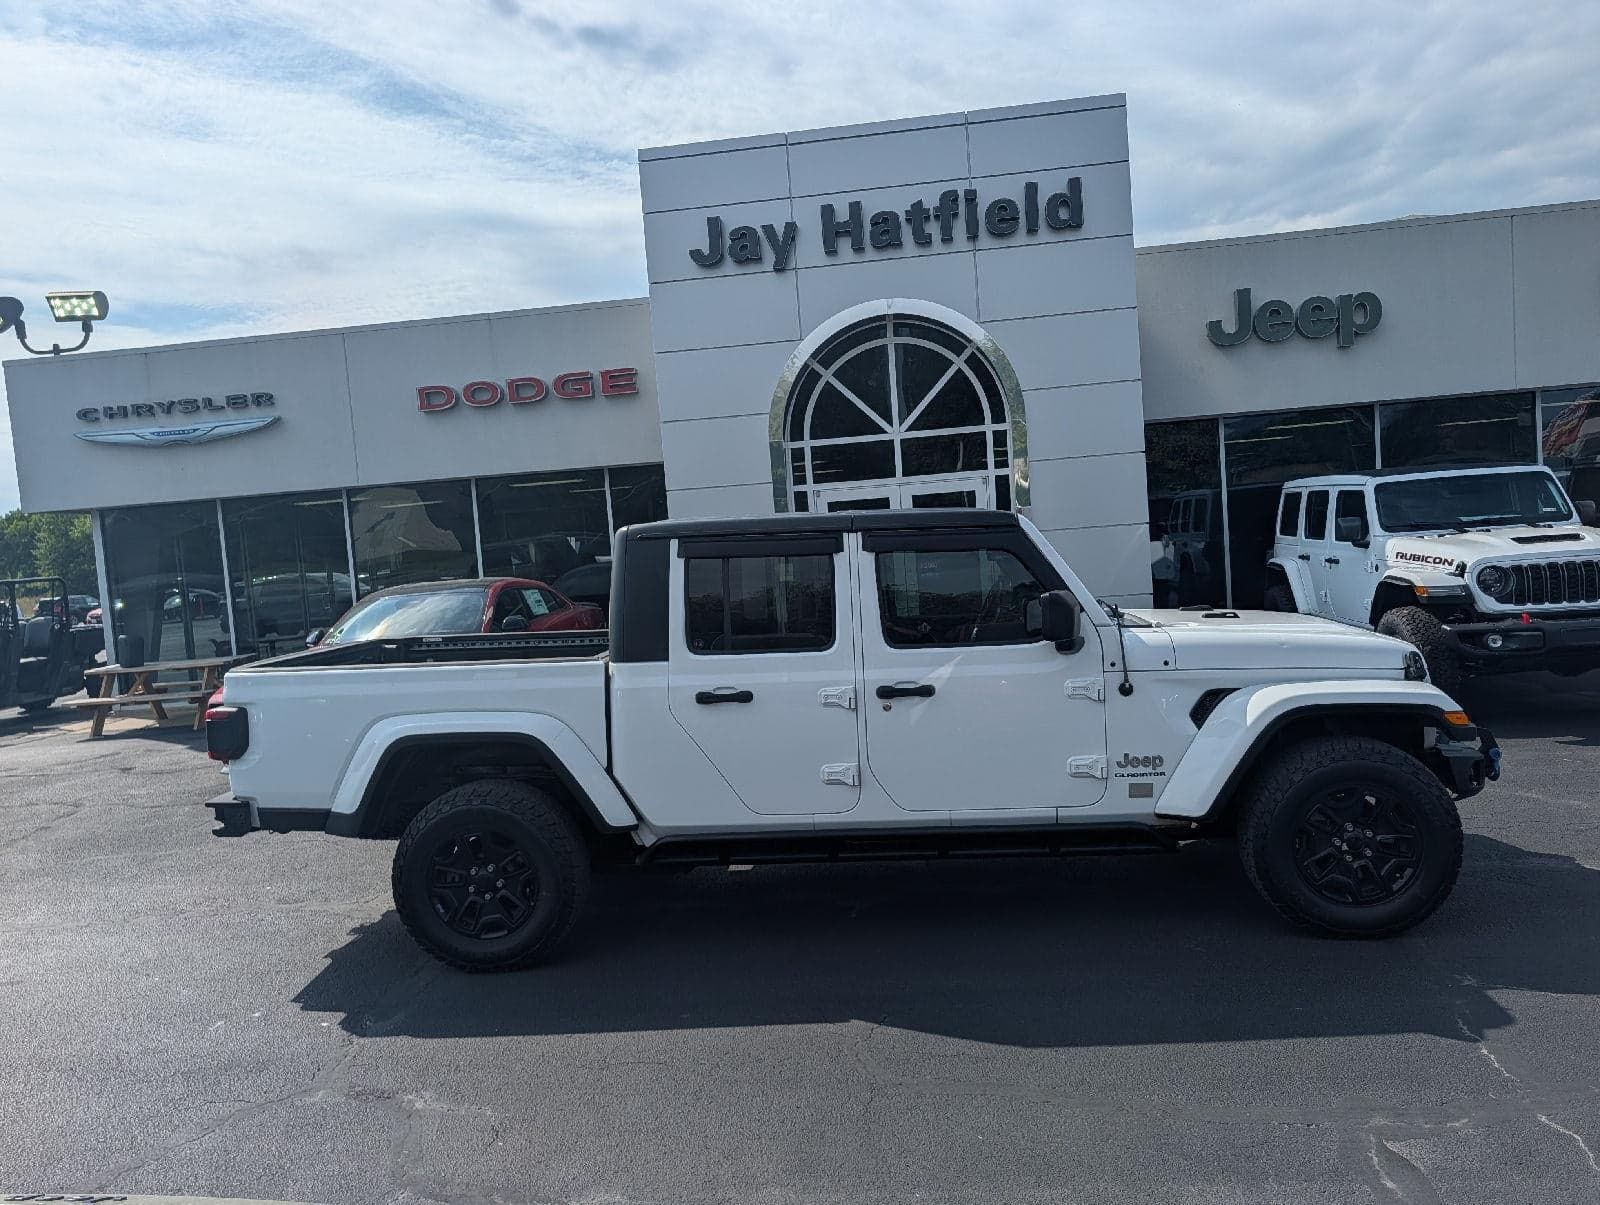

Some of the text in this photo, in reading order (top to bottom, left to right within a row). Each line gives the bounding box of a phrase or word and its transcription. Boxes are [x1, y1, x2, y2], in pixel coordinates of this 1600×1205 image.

[689, 177, 1083, 272] Jay Hatfield
[1206, 288, 1382, 347] Jeep
[76, 392, 275, 422] CHRYSLER
[416, 368, 638, 412] DODGE
[1395, 551, 1455, 567] RUBICON
[1115, 752, 1165, 771] Jeep
